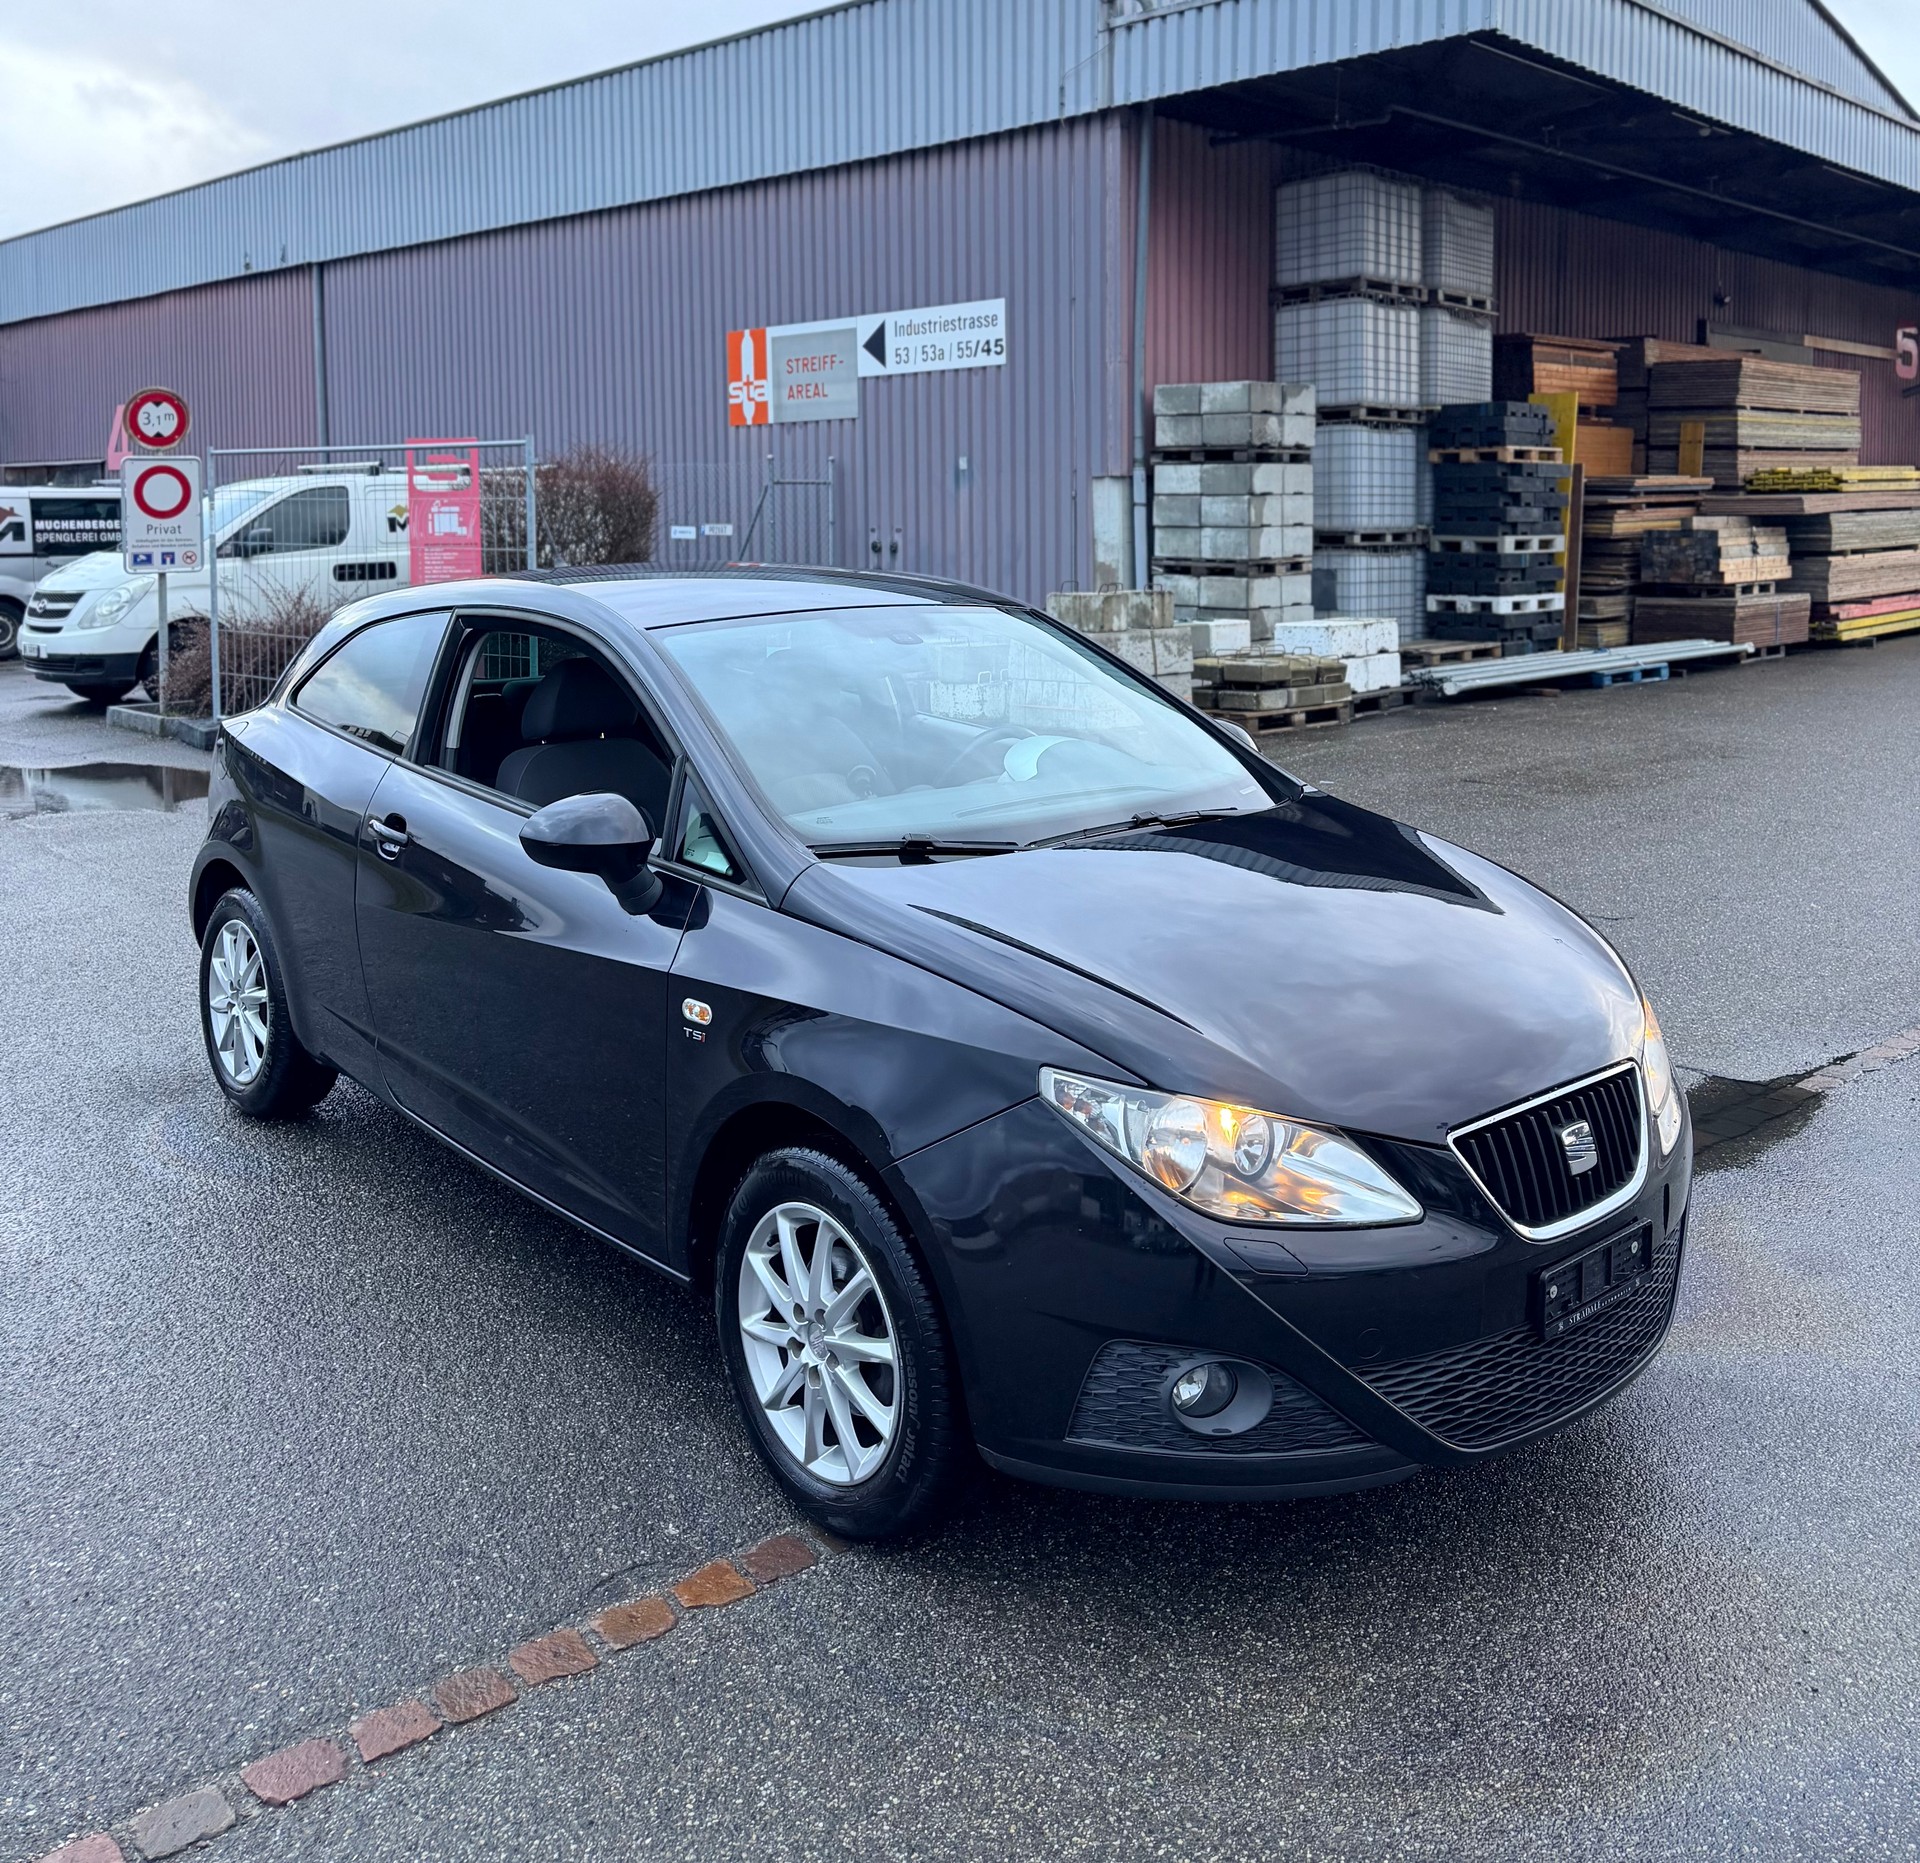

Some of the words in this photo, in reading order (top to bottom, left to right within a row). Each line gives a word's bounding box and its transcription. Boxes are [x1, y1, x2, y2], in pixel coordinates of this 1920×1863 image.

[894, 313, 999, 338] Industriestrasse
[895, 347, 910, 365] 53
[921, 343, 946, 363] 53a
[786, 354, 844, 375] STREIFF-
[787, 382, 828, 401] AREAL
[35, 520, 121, 530] MUCHENBERGE
[146, 523, 182, 535] Privat
[35, 532, 98, 543] SPENGLEREI
[99, 531, 122, 542] GMB
